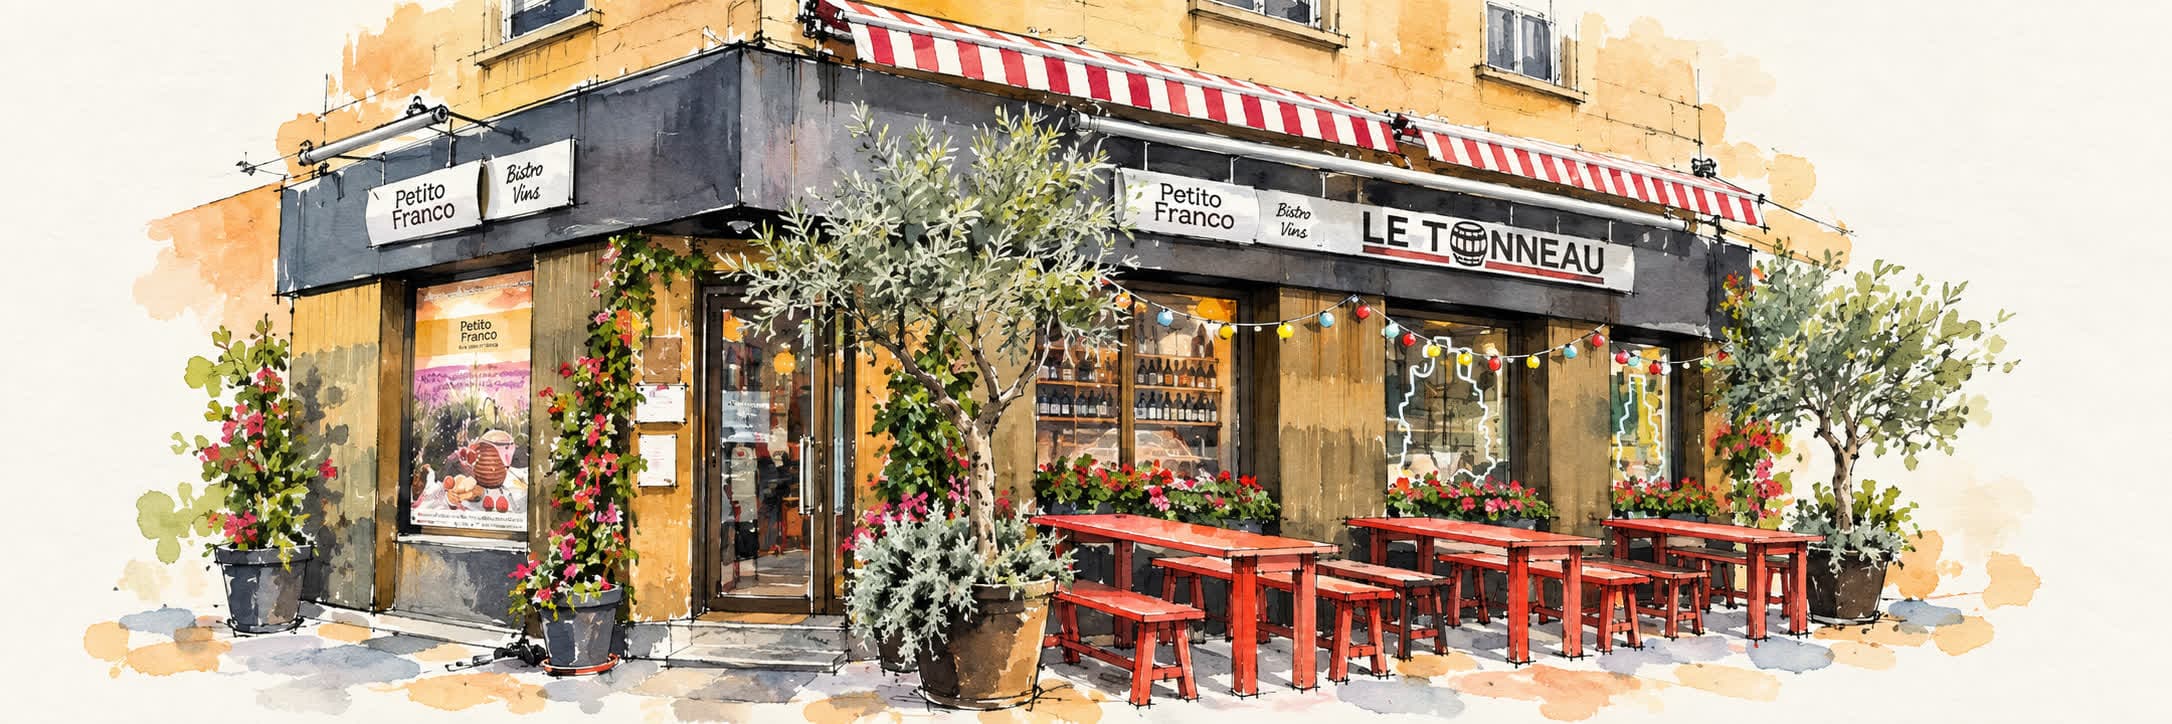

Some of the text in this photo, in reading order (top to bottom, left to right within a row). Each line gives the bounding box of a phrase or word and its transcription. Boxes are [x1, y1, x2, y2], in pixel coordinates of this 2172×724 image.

[506, 162, 544, 185] Bistro
[395, 183, 445, 209] Petito
[513, 184, 541, 204] Vins
[1160, 182, 1222, 209] Petito
[392, 202, 455, 230] Franco
[1154, 201, 1235, 230] Franco
[1275, 202, 1311, 220] Bistro
[1280, 221, 1308, 239] Vins
[1362, 210, 1409, 248] LE
[460, 320, 492, 332] Petito
[461, 331, 498, 342] Franco
